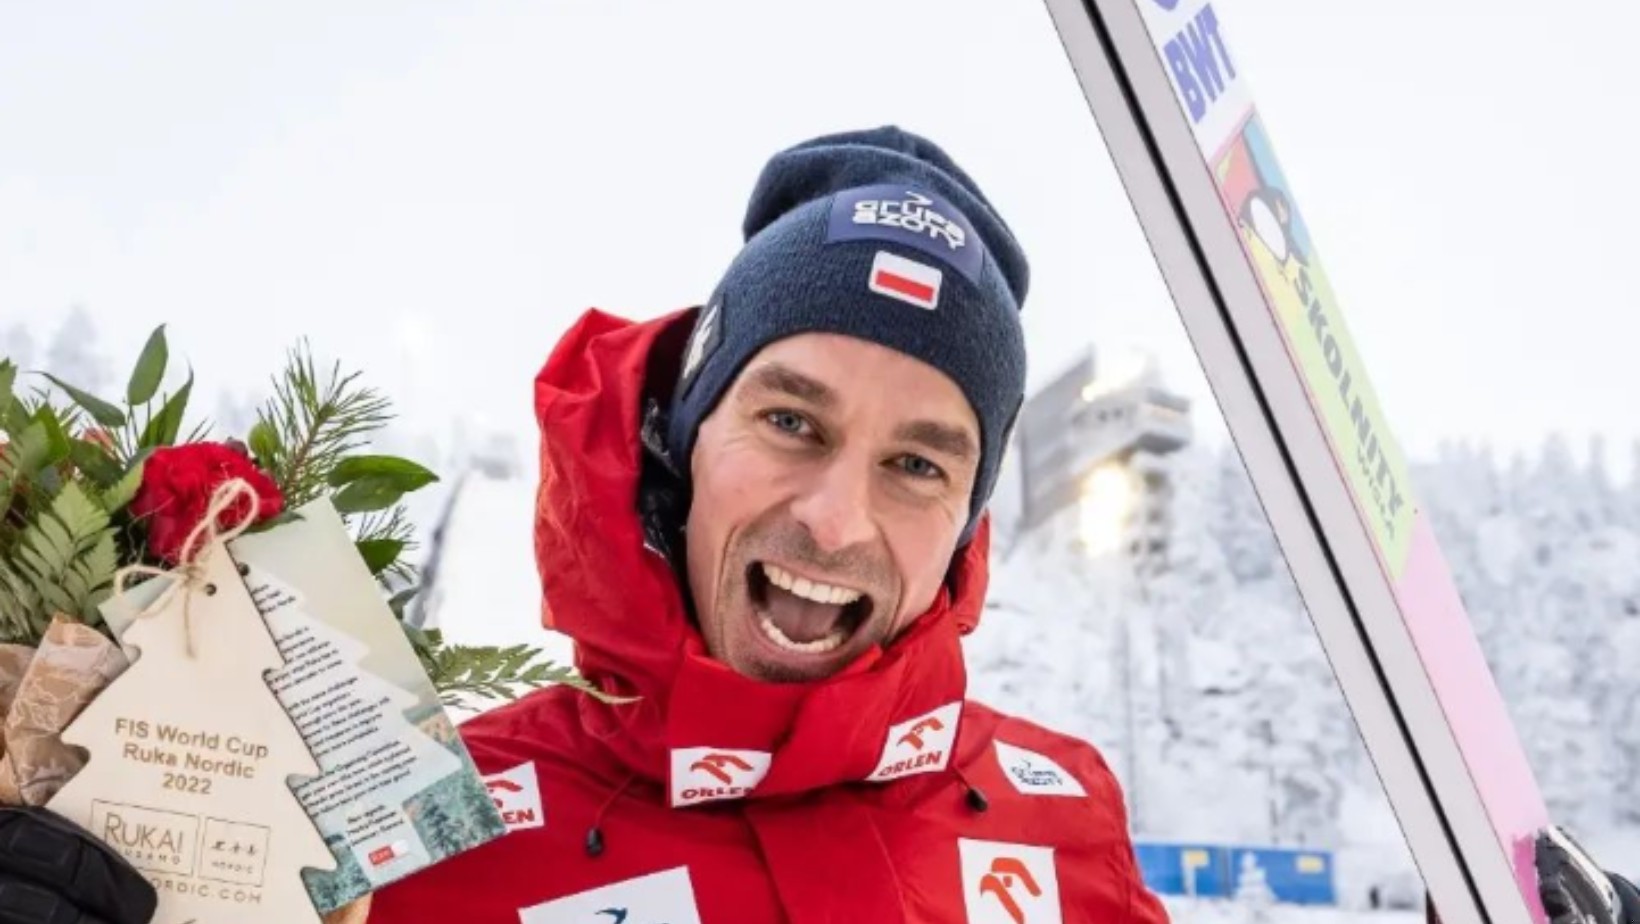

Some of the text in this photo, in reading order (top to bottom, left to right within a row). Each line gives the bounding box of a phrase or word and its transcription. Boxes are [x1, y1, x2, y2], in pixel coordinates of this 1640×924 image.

[1163, 2, 1236, 124] BWT
[114, 718, 269, 760] FIS World Cup
[122, 742, 255, 780] Ruka Nordic
[878, 751, 943, 777] ORLEN
[162, 772, 212, 795] 2022
